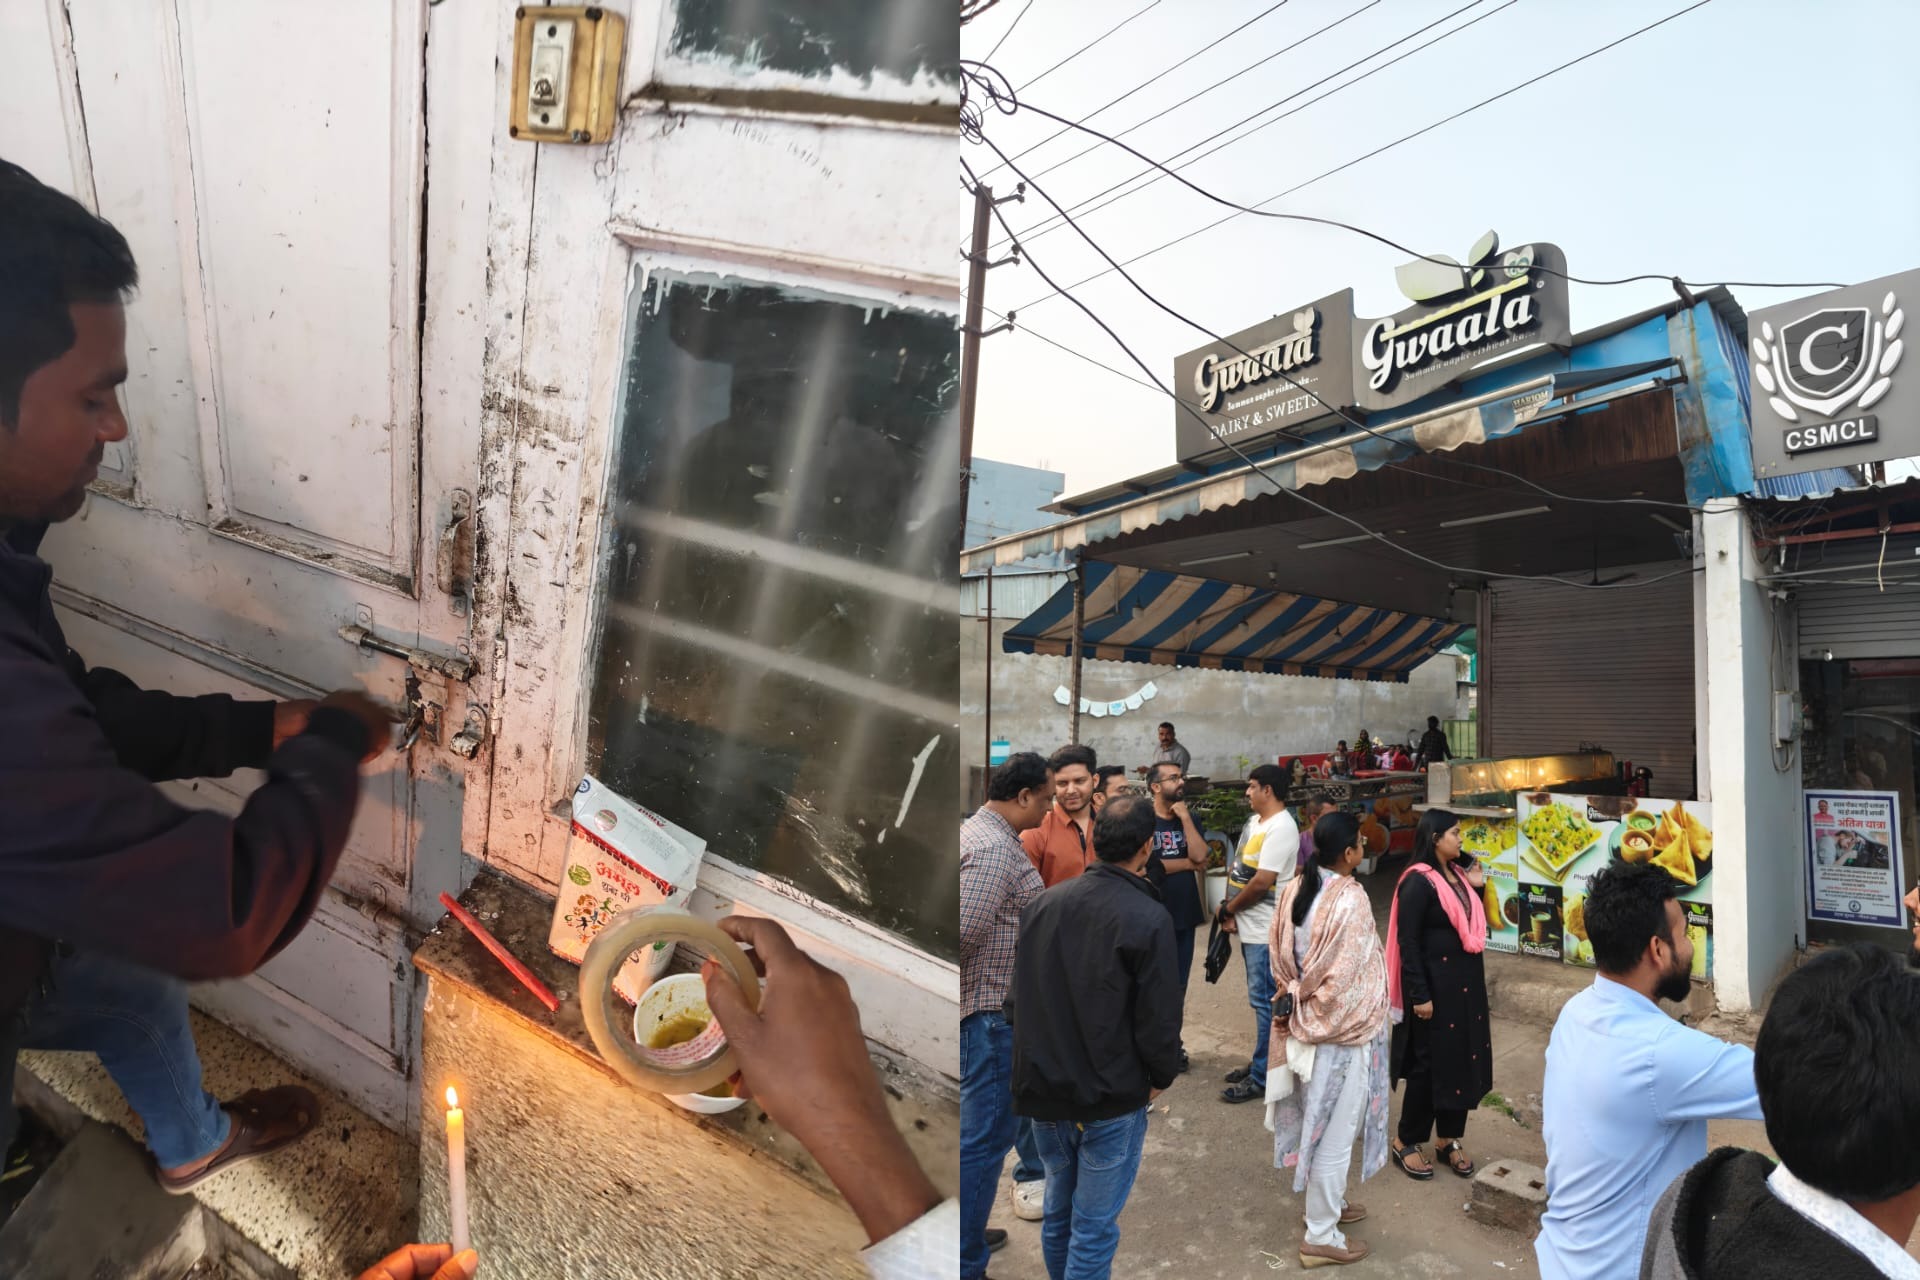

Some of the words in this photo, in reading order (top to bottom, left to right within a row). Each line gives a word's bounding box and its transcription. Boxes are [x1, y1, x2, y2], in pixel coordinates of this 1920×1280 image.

[1362, 294, 1533, 390] Gwaala
[1799, 323, 1849, 376] C
[1194, 335, 1315, 413] Gwaala
[1210, 414, 1250, 440] DAIRY
[1252, 411, 1264, 426] &
[1266, 391, 1319, 422] SWEETS
[1786, 418, 1873, 450] CSMCL
